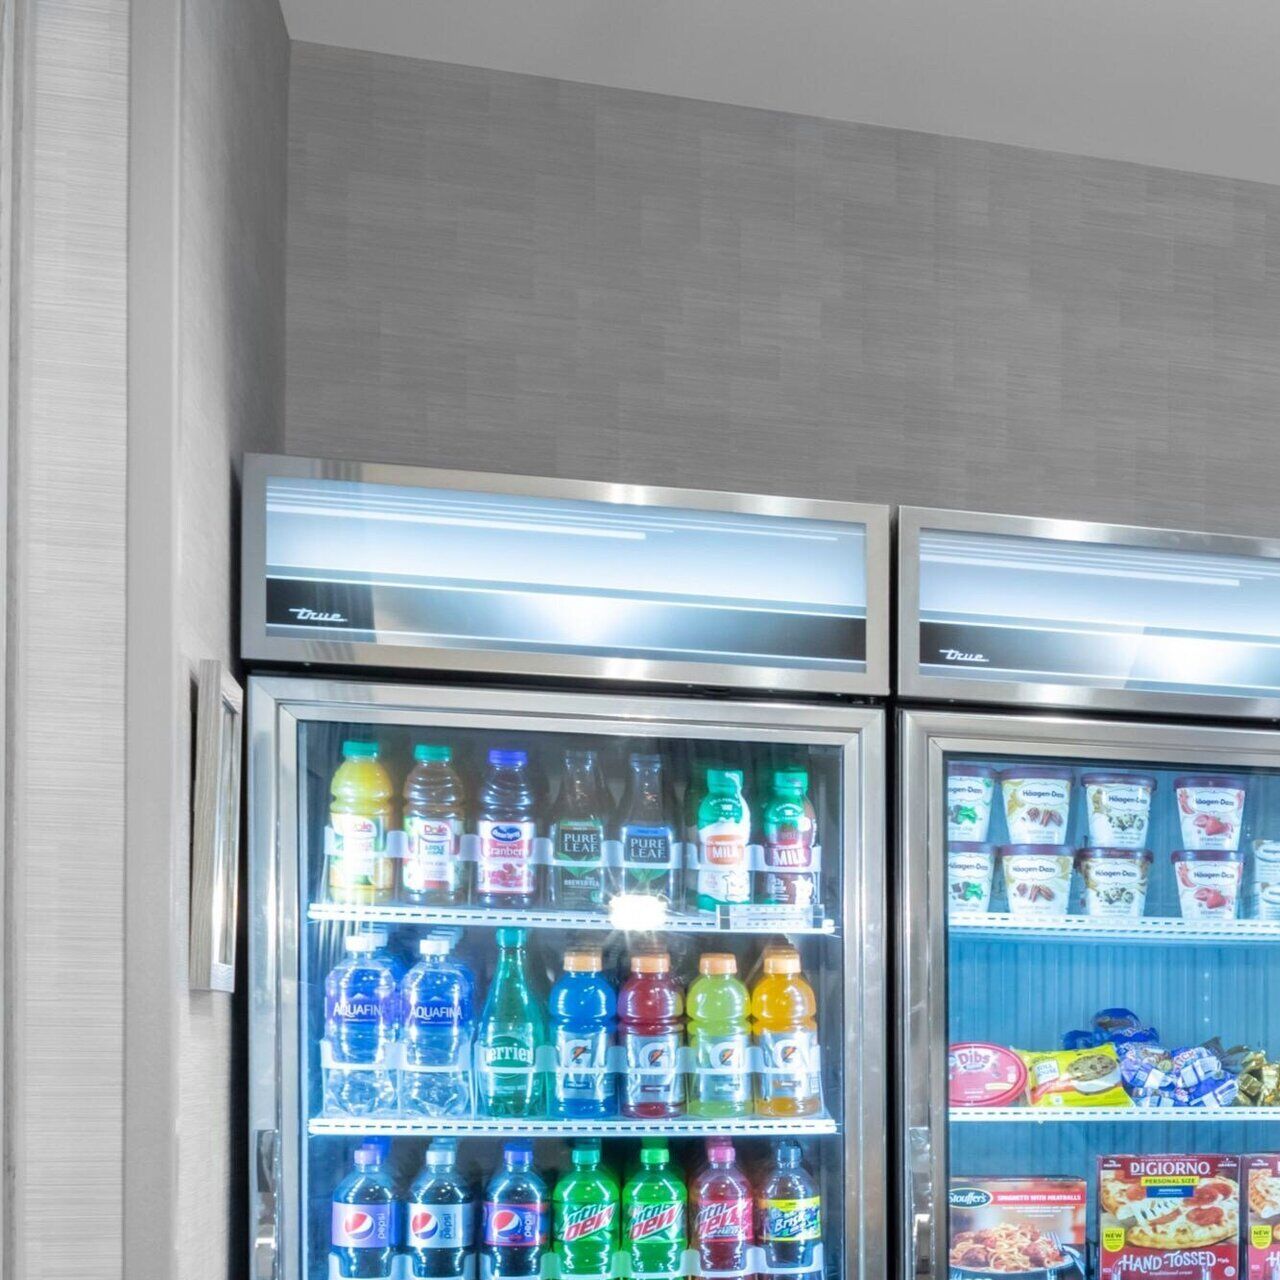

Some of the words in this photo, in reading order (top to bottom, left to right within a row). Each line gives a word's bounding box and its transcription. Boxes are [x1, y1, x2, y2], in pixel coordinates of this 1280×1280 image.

[564, 833, 597, 843] PURE
[630, 838, 664, 849] PURE
[564, 843, 597, 853] LEAF
[630, 848, 666, 859] LEAF
[958, 1048, 992, 1067] Dibs
[1131, 1161, 1211, 1176] DIGIORNO
[1120, 1250, 1216, 1271] HAND-TOSSED
